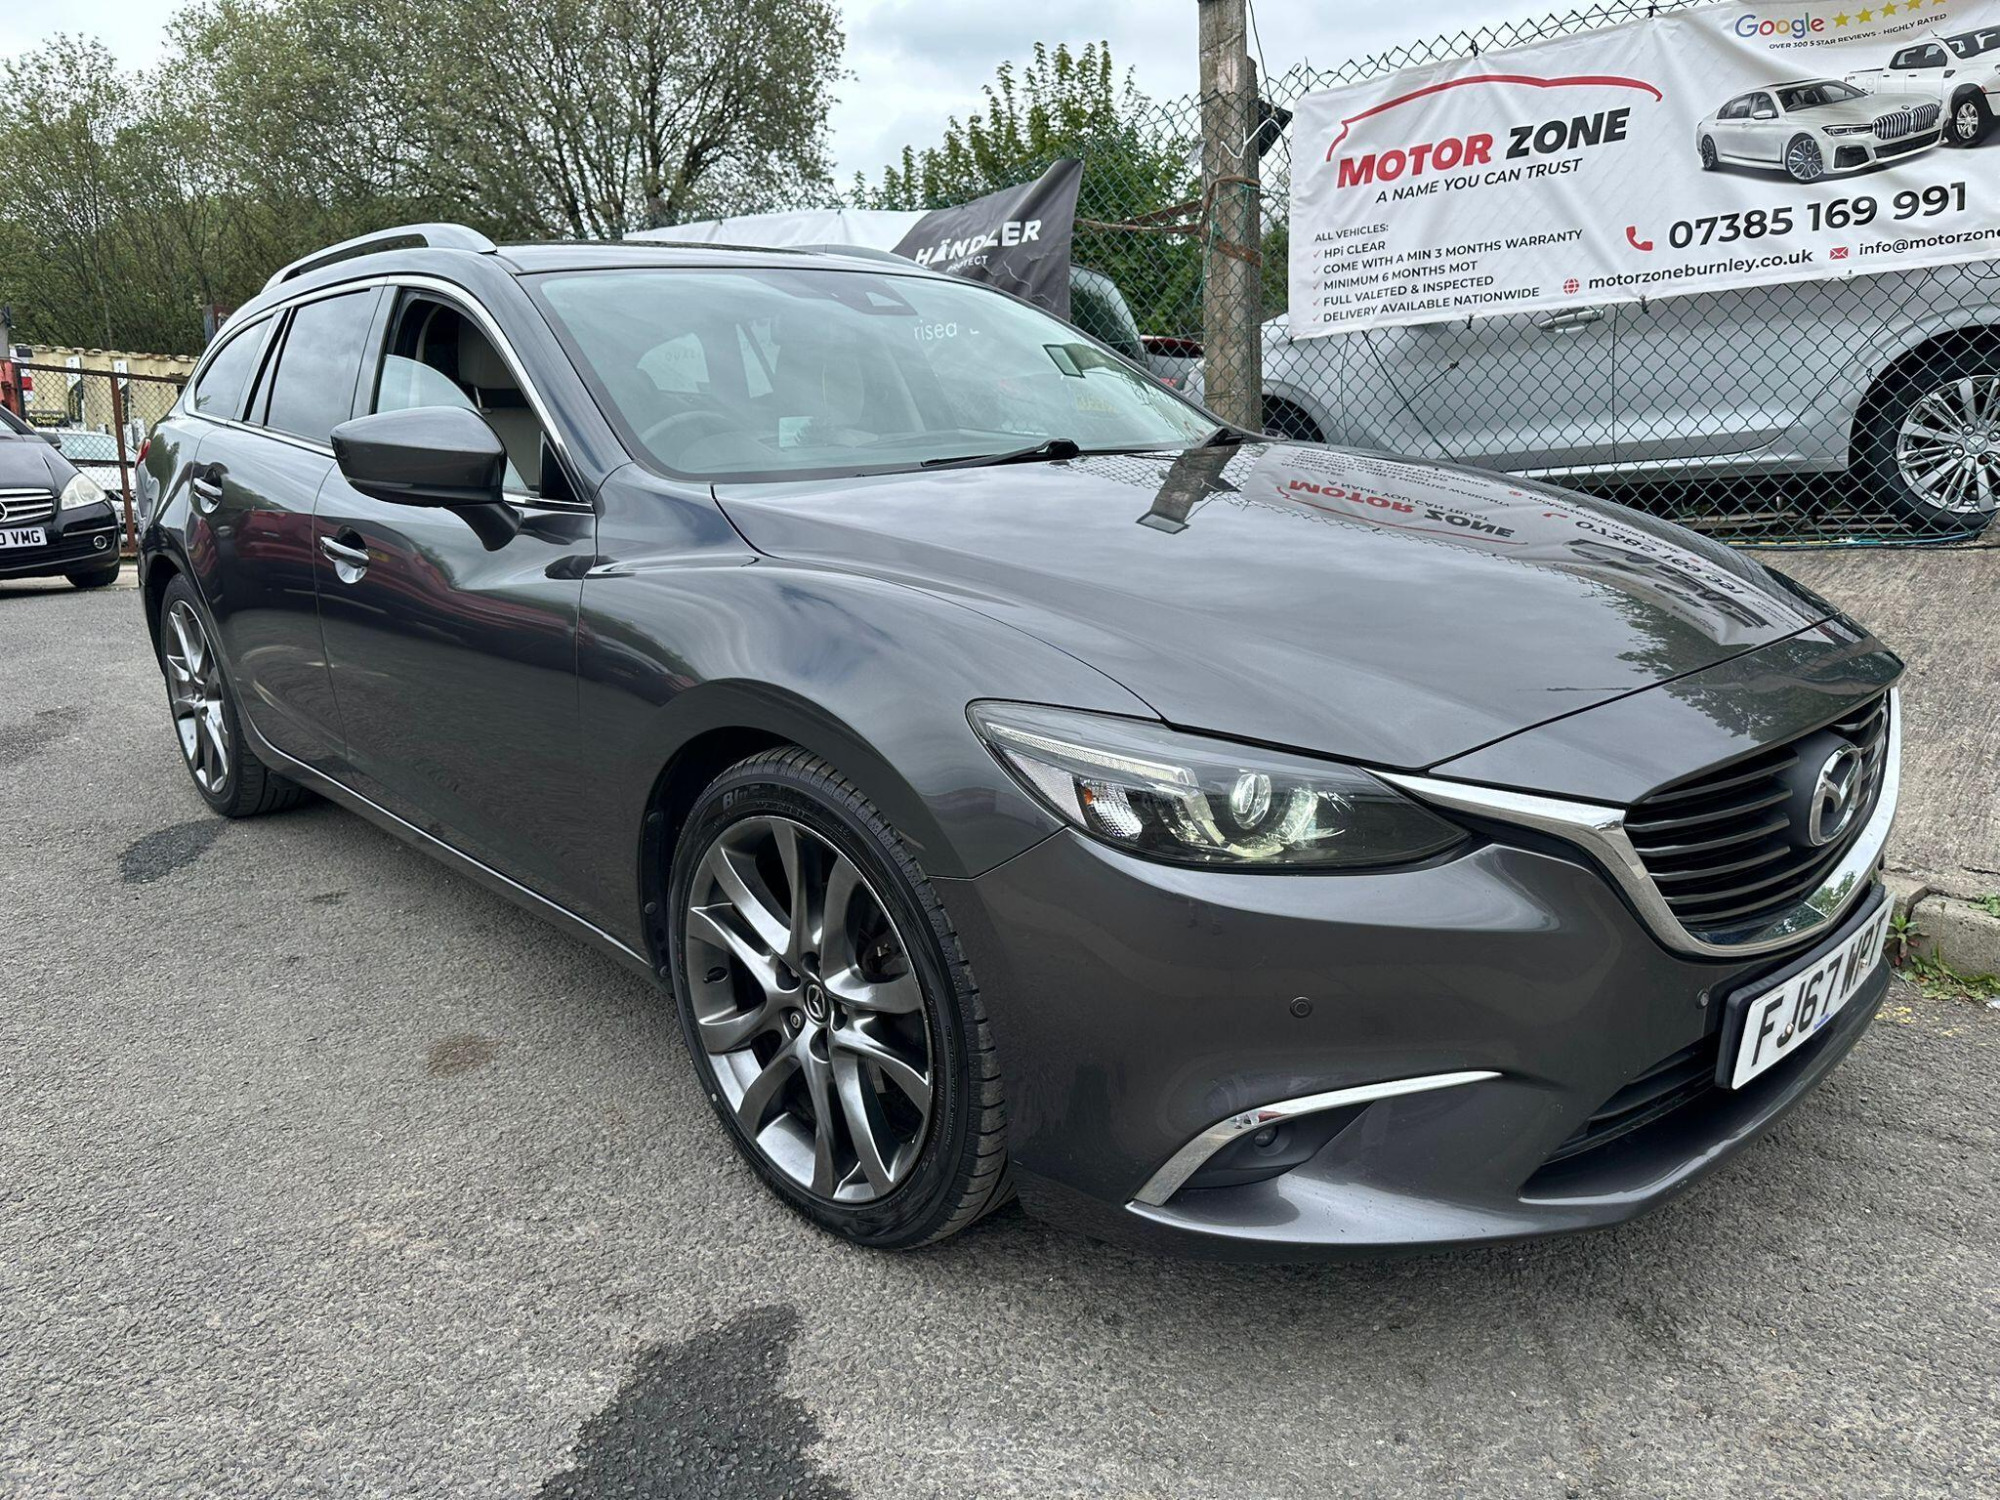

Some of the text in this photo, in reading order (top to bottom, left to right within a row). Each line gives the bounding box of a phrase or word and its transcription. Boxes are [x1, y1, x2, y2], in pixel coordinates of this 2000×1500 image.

[1735, 12, 1825, 39] Google
[1769, 42, 1791, 50] OVER
[1838, 31, 1876, 43] REVIEWS
[1883, 21, 1915, 35] HIGHLY
[1917, 13, 1947, 26] RATED
[1337, 107, 1631, 188] MOTOR ZONE
[1375, 158, 1583, 203] A NAME YOU CAN TRUST
[1315, 223, 1389, 242] ALL VEHICLES:
[1668, 181, 1966, 249] 07385 169 991
[1323, 229, 1583, 274] COME WITH A MIN 3 MONTHS WARRANTY
[1324, 241, 1386, 259] HPi CLEAR
[1323, 260, 1478, 291] MINIMUM 6 MONTHS MOT
[1588, 249, 1814, 289] motorzoneburnley.co.uk
[1323, 275, 1494, 307] FULL VALETED & INSPECTED
[1323, 287, 1540, 322] DELIVERY AVAILABLE NATIONWIDE
[10, 529, 41, 545] VMG
[1751, 953, 1844, 1067] FJ67
